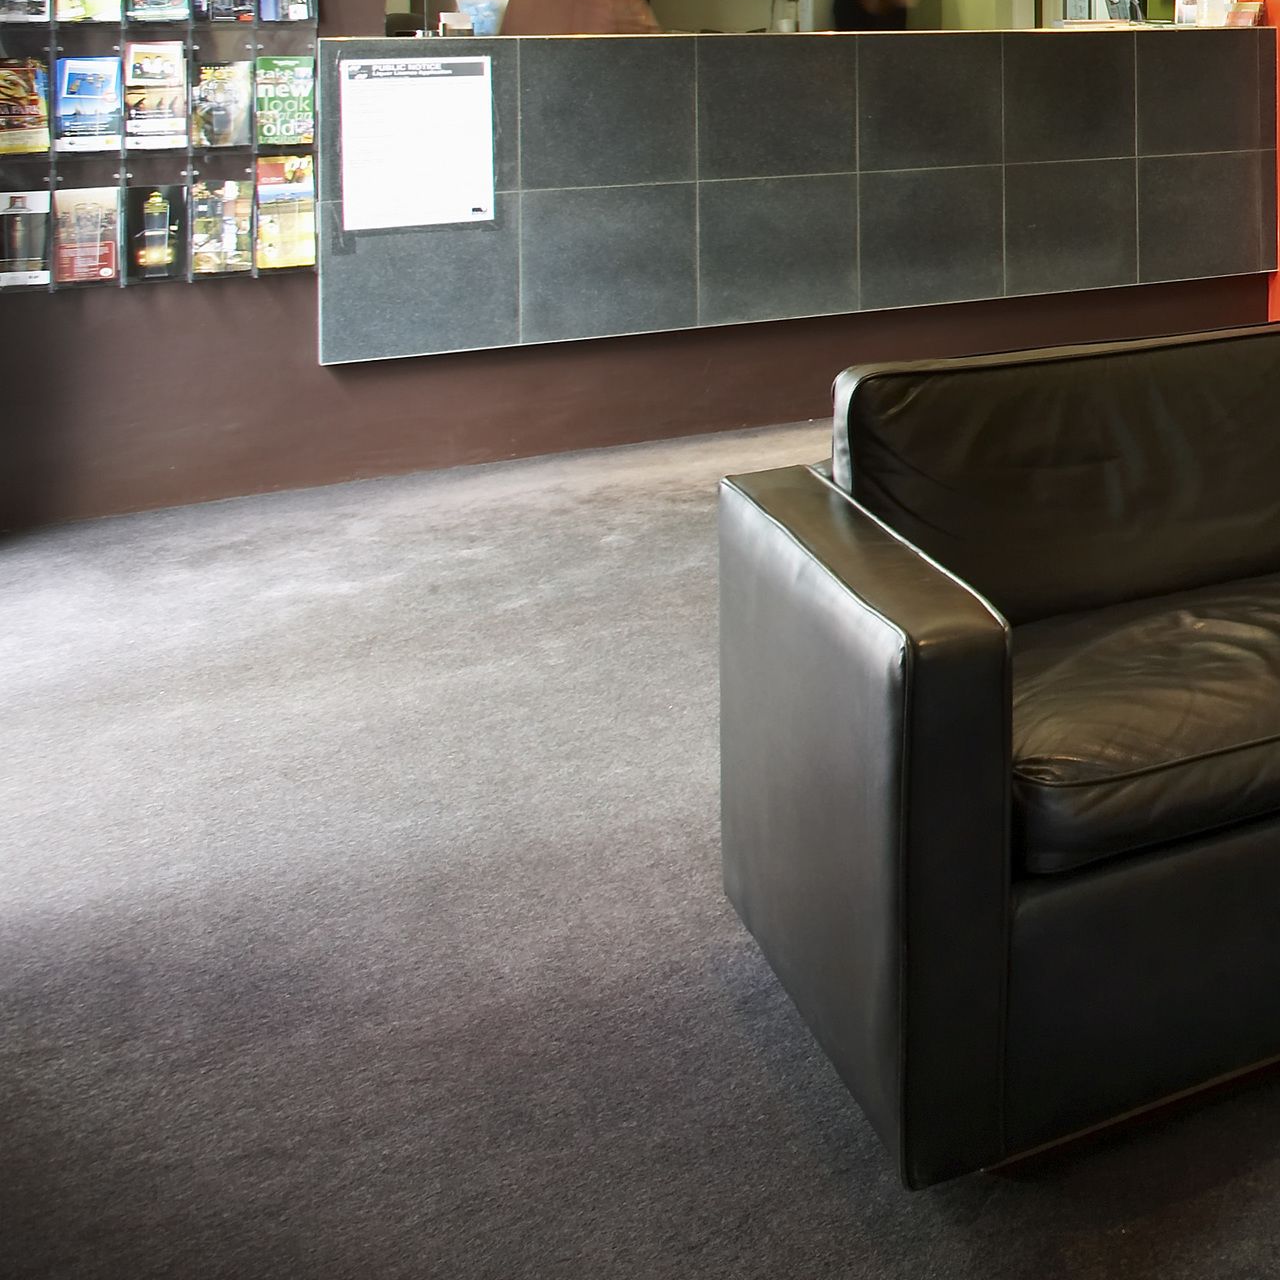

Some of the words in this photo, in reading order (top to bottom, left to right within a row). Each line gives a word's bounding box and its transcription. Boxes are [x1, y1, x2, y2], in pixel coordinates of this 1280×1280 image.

[256, 68, 293, 80] take
[372, 63, 407, 71] PUBLIC
[408, 62, 442, 71] NOTICE
[256, 81, 313, 97] new
[263, 96, 311, 111] look
[262, 119, 295, 136] old
